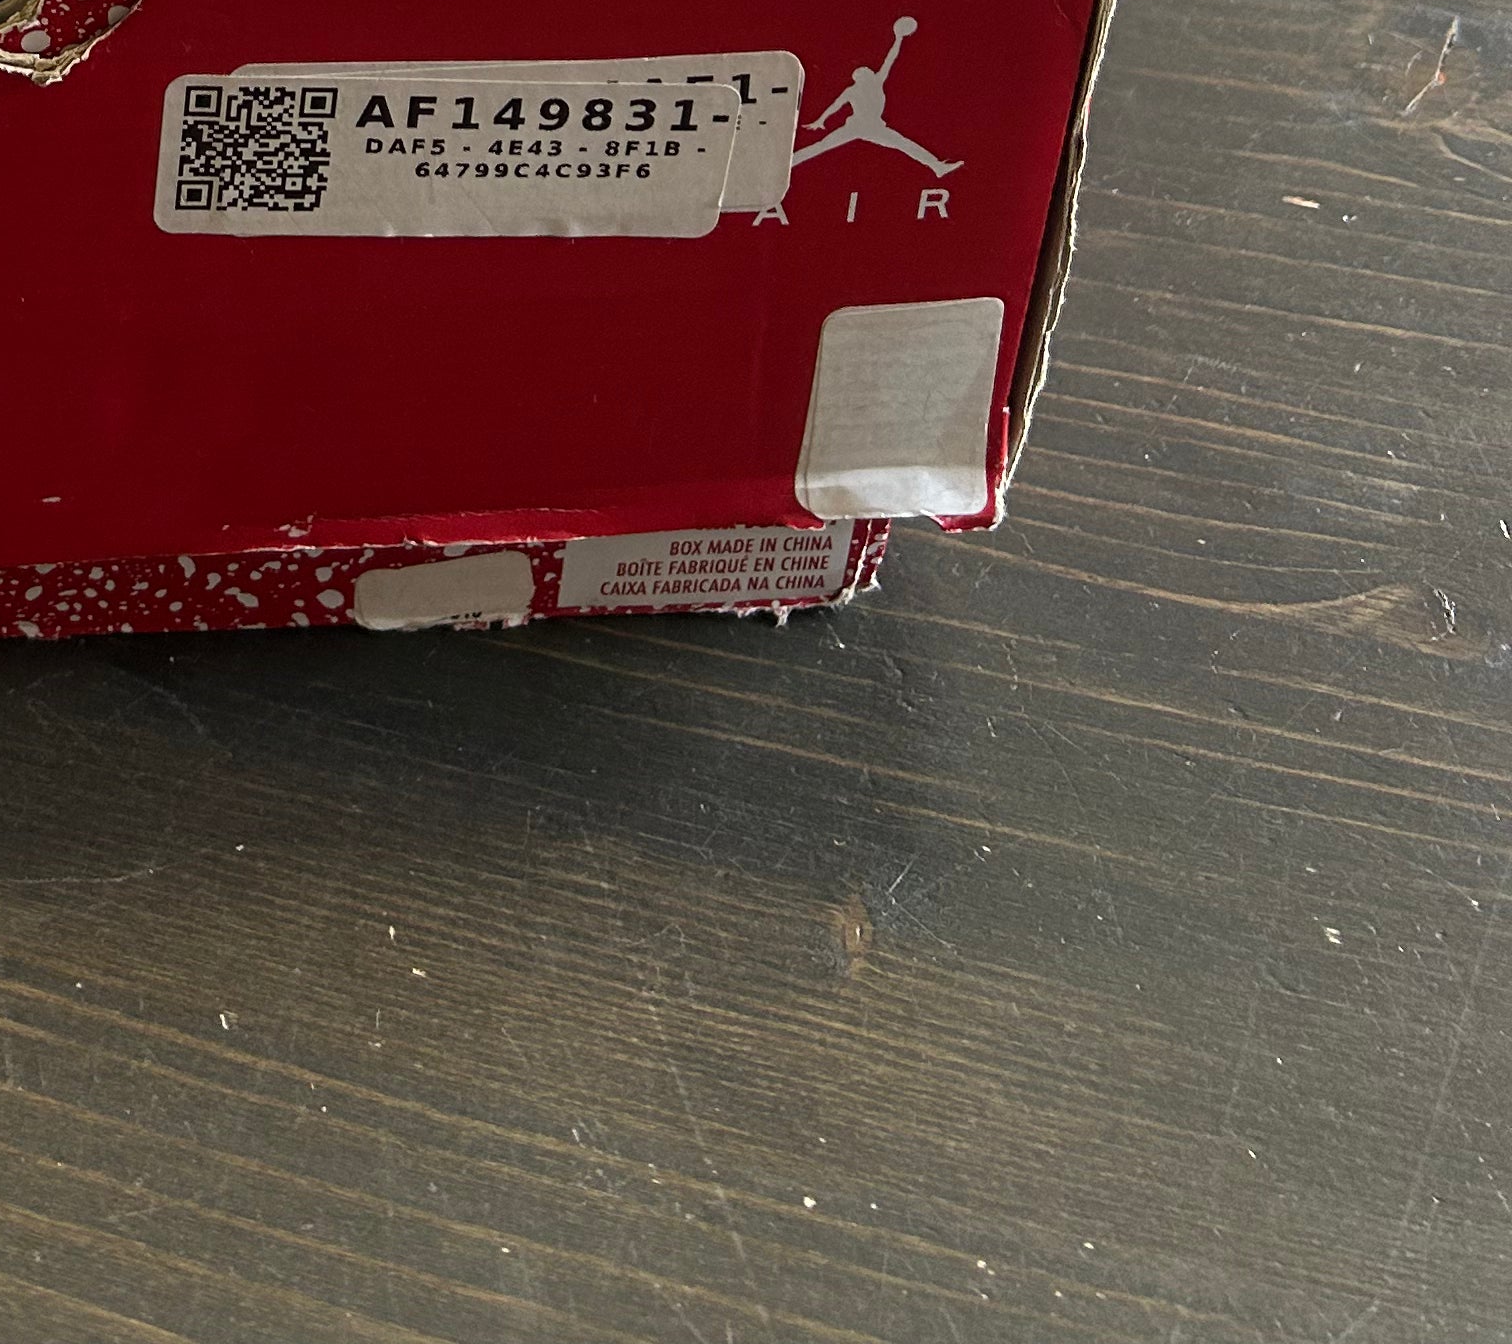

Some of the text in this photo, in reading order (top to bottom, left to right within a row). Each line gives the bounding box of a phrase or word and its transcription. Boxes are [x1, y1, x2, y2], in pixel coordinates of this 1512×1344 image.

[414, 161, 651, 179] 64799C4C93F6
[669, 535, 833, 556] BOX MADE IN CHINA
[616, 555, 830, 577] BOÎTE FABRIQUÉ EN CHINE
[600, 574, 826, 595] CAIXA FABRICADA NA CHINA
